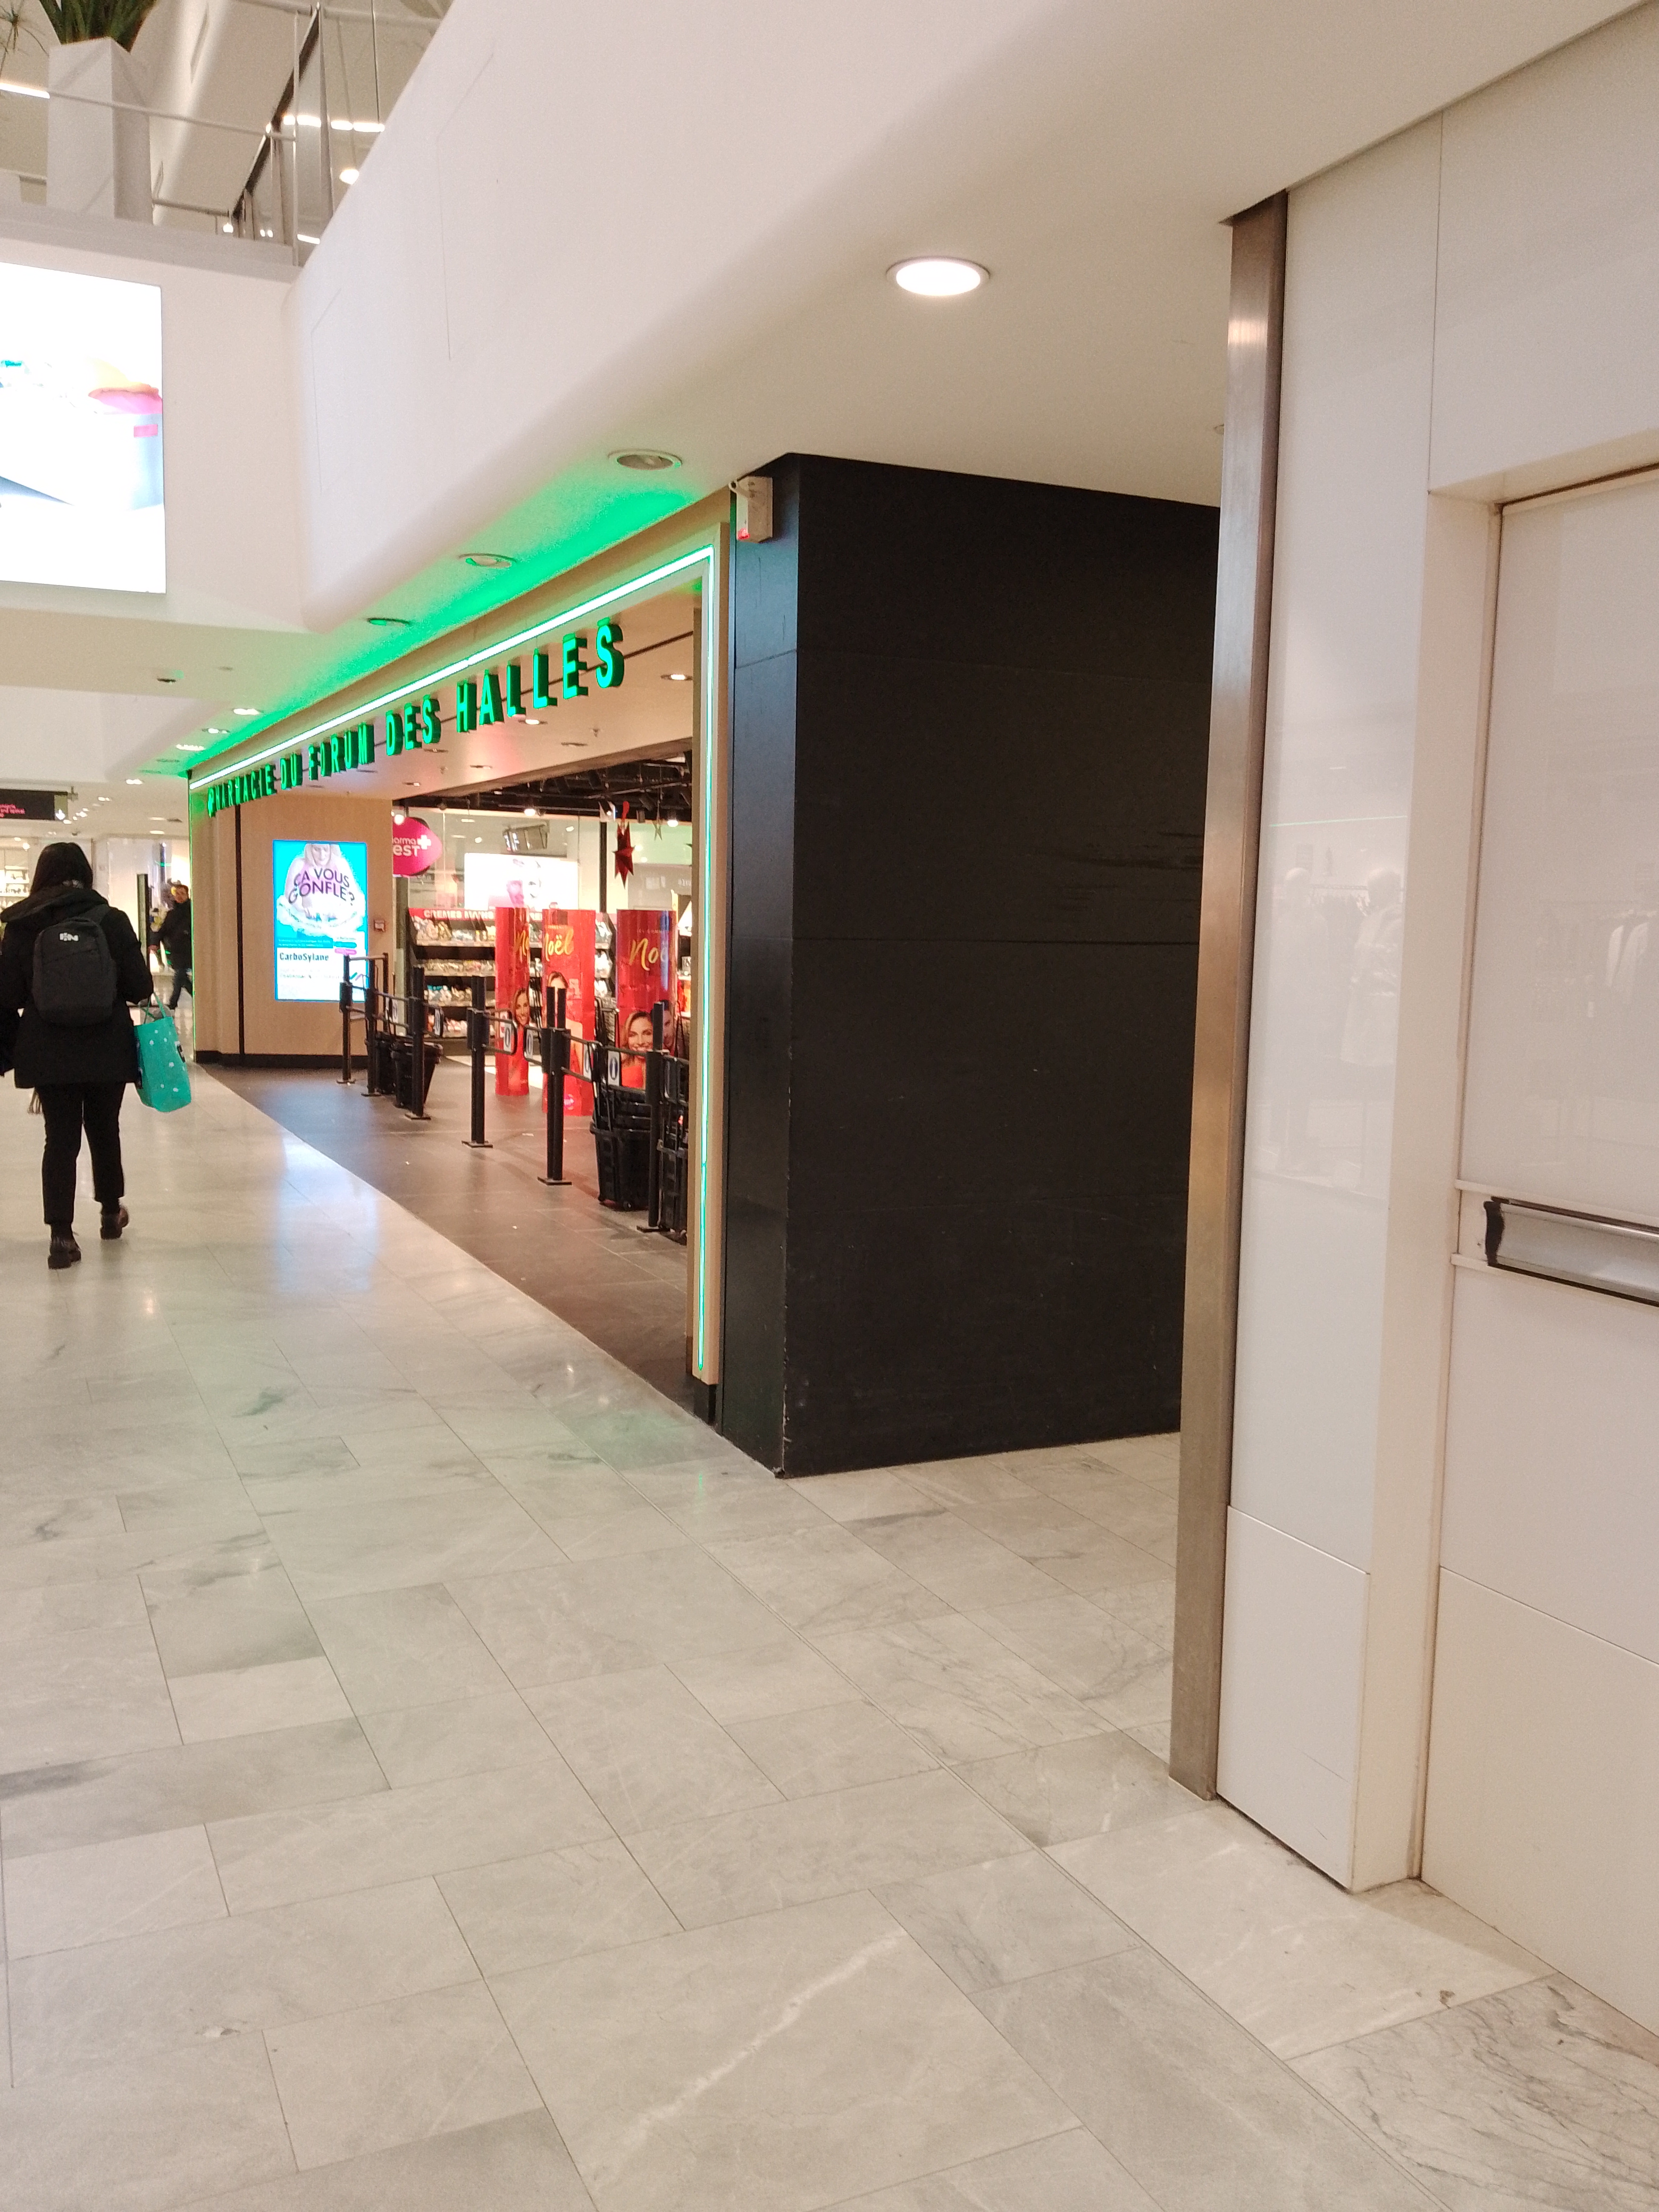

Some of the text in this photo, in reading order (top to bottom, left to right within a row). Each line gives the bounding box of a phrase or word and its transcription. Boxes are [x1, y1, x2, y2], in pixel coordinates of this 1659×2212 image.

[207, 618, 624, 817] PHARMACIE DU FORUM DES HALLES
[314, 868, 349, 887] VOUS
[280, 952, 329, 963] CarboSylane
